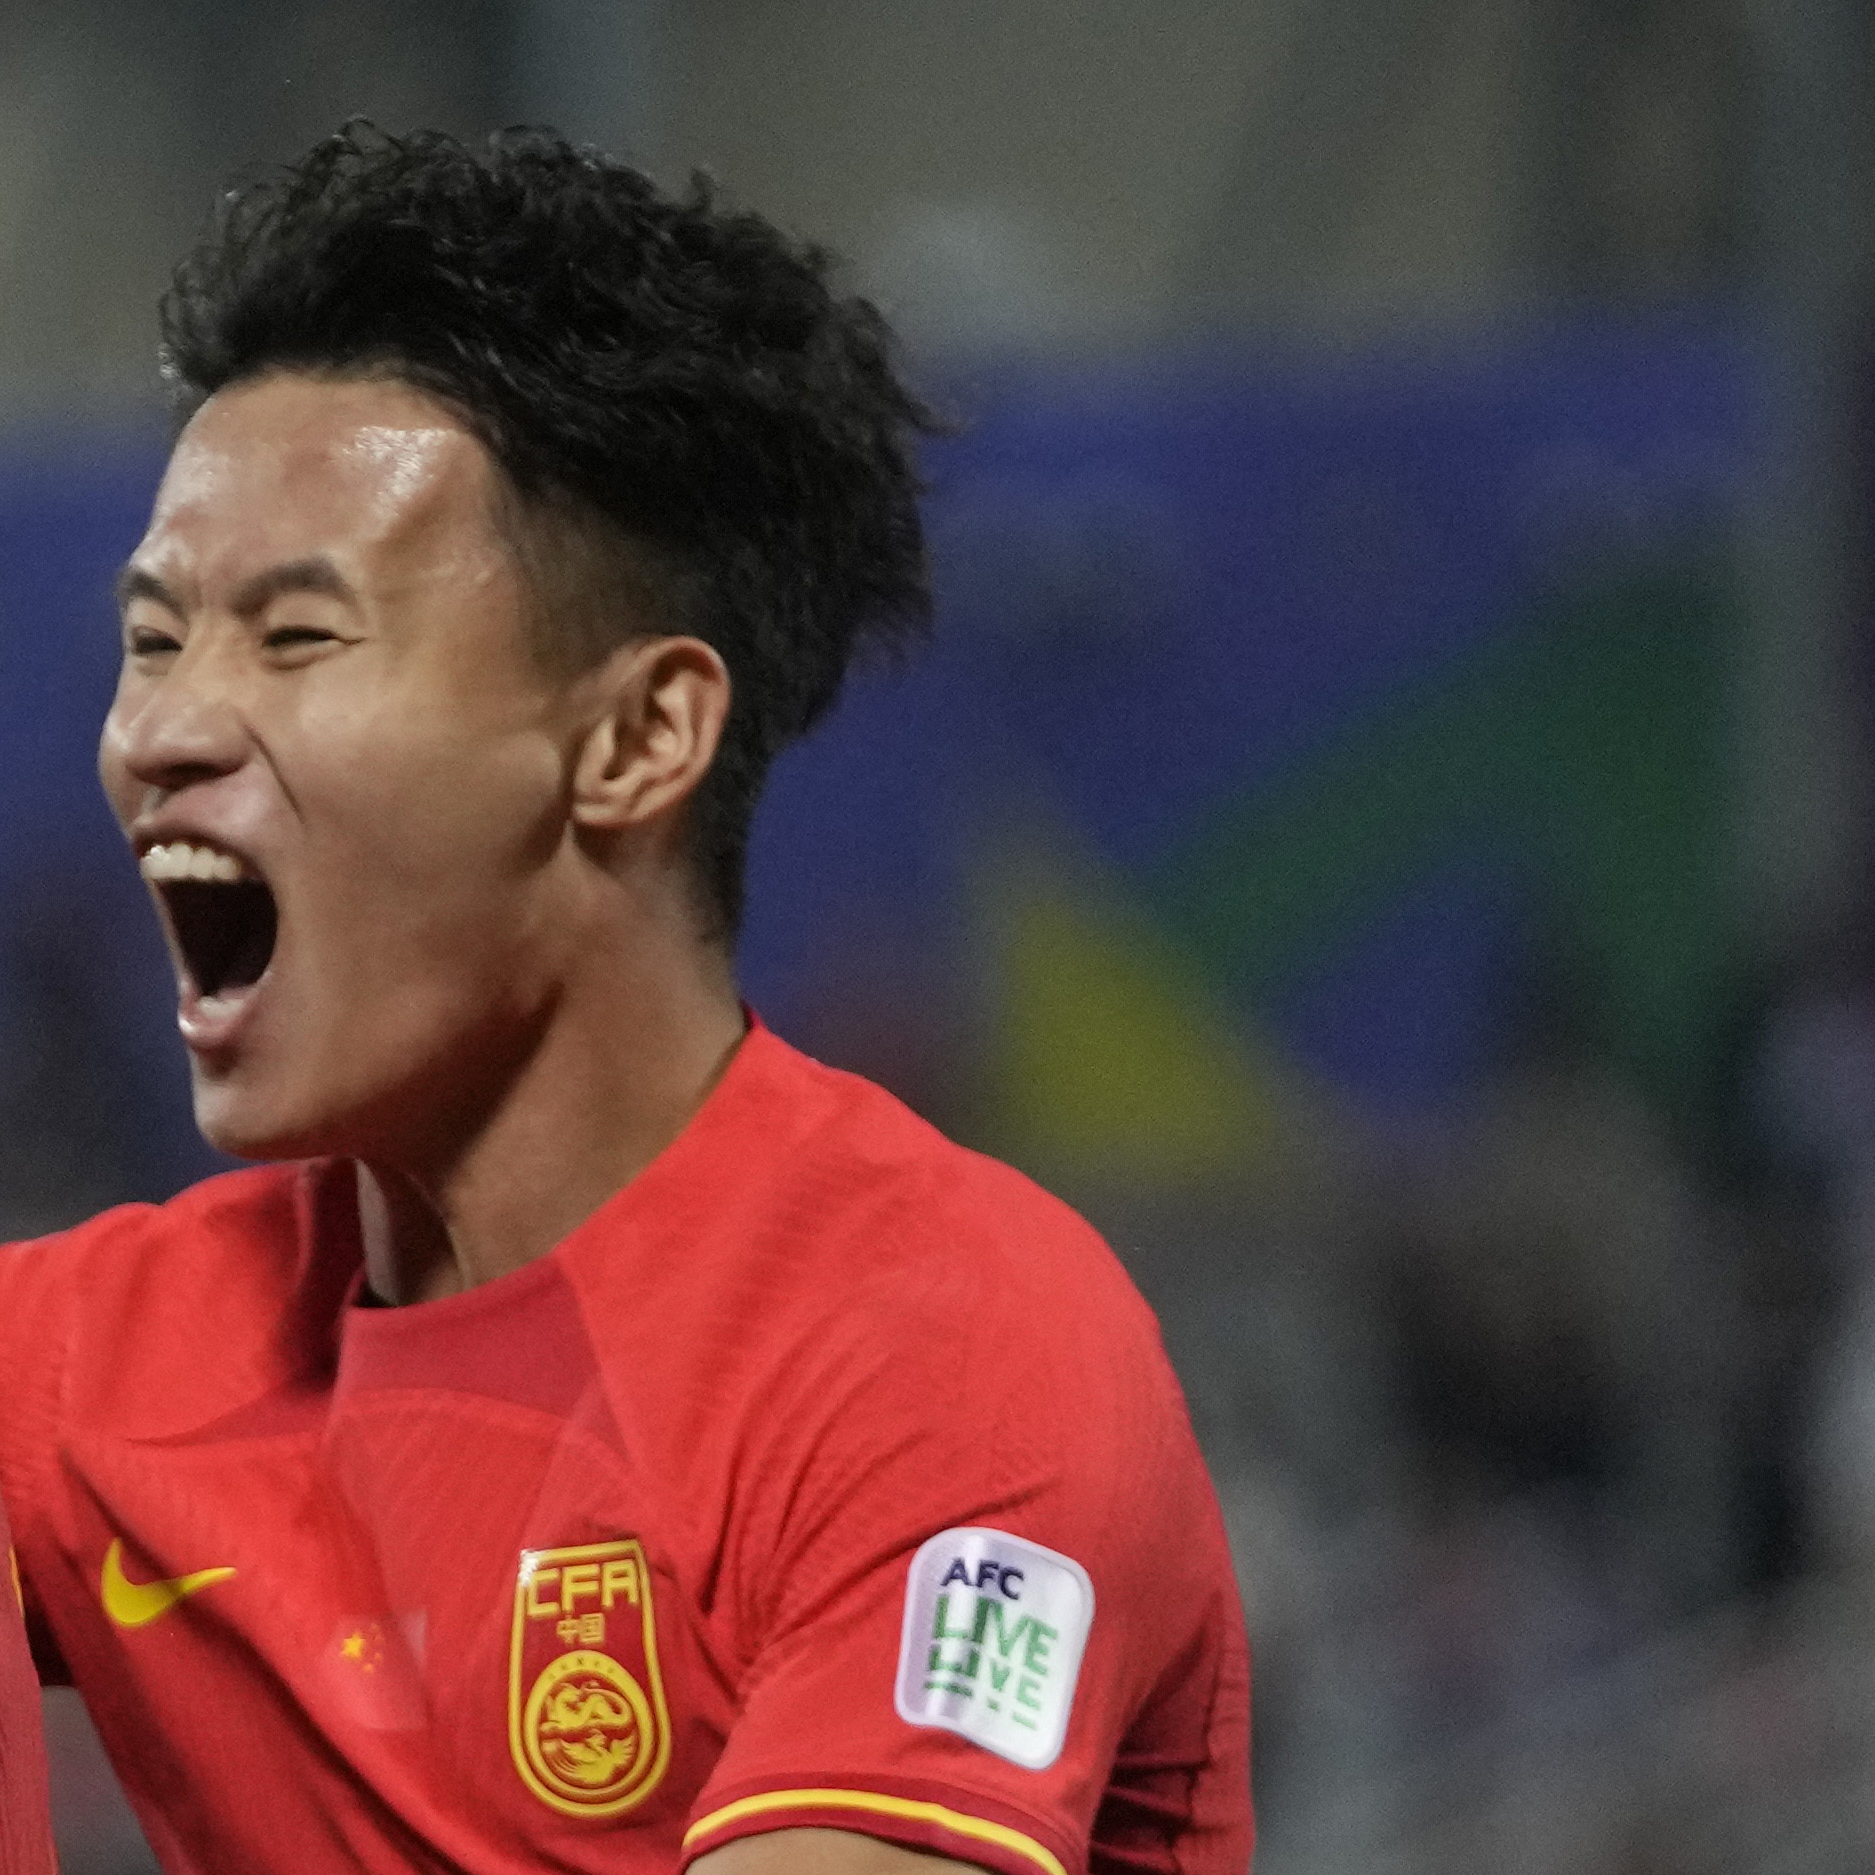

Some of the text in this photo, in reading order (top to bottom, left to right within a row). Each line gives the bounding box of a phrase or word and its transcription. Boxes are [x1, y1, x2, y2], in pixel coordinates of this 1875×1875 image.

[526, 1559, 639, 1618] CFA
[940, 1557, 1025, 1600] AFC
[556, 1612, 605, 1643] 中国
[933, 1595, 1058, 1677] LIVE
